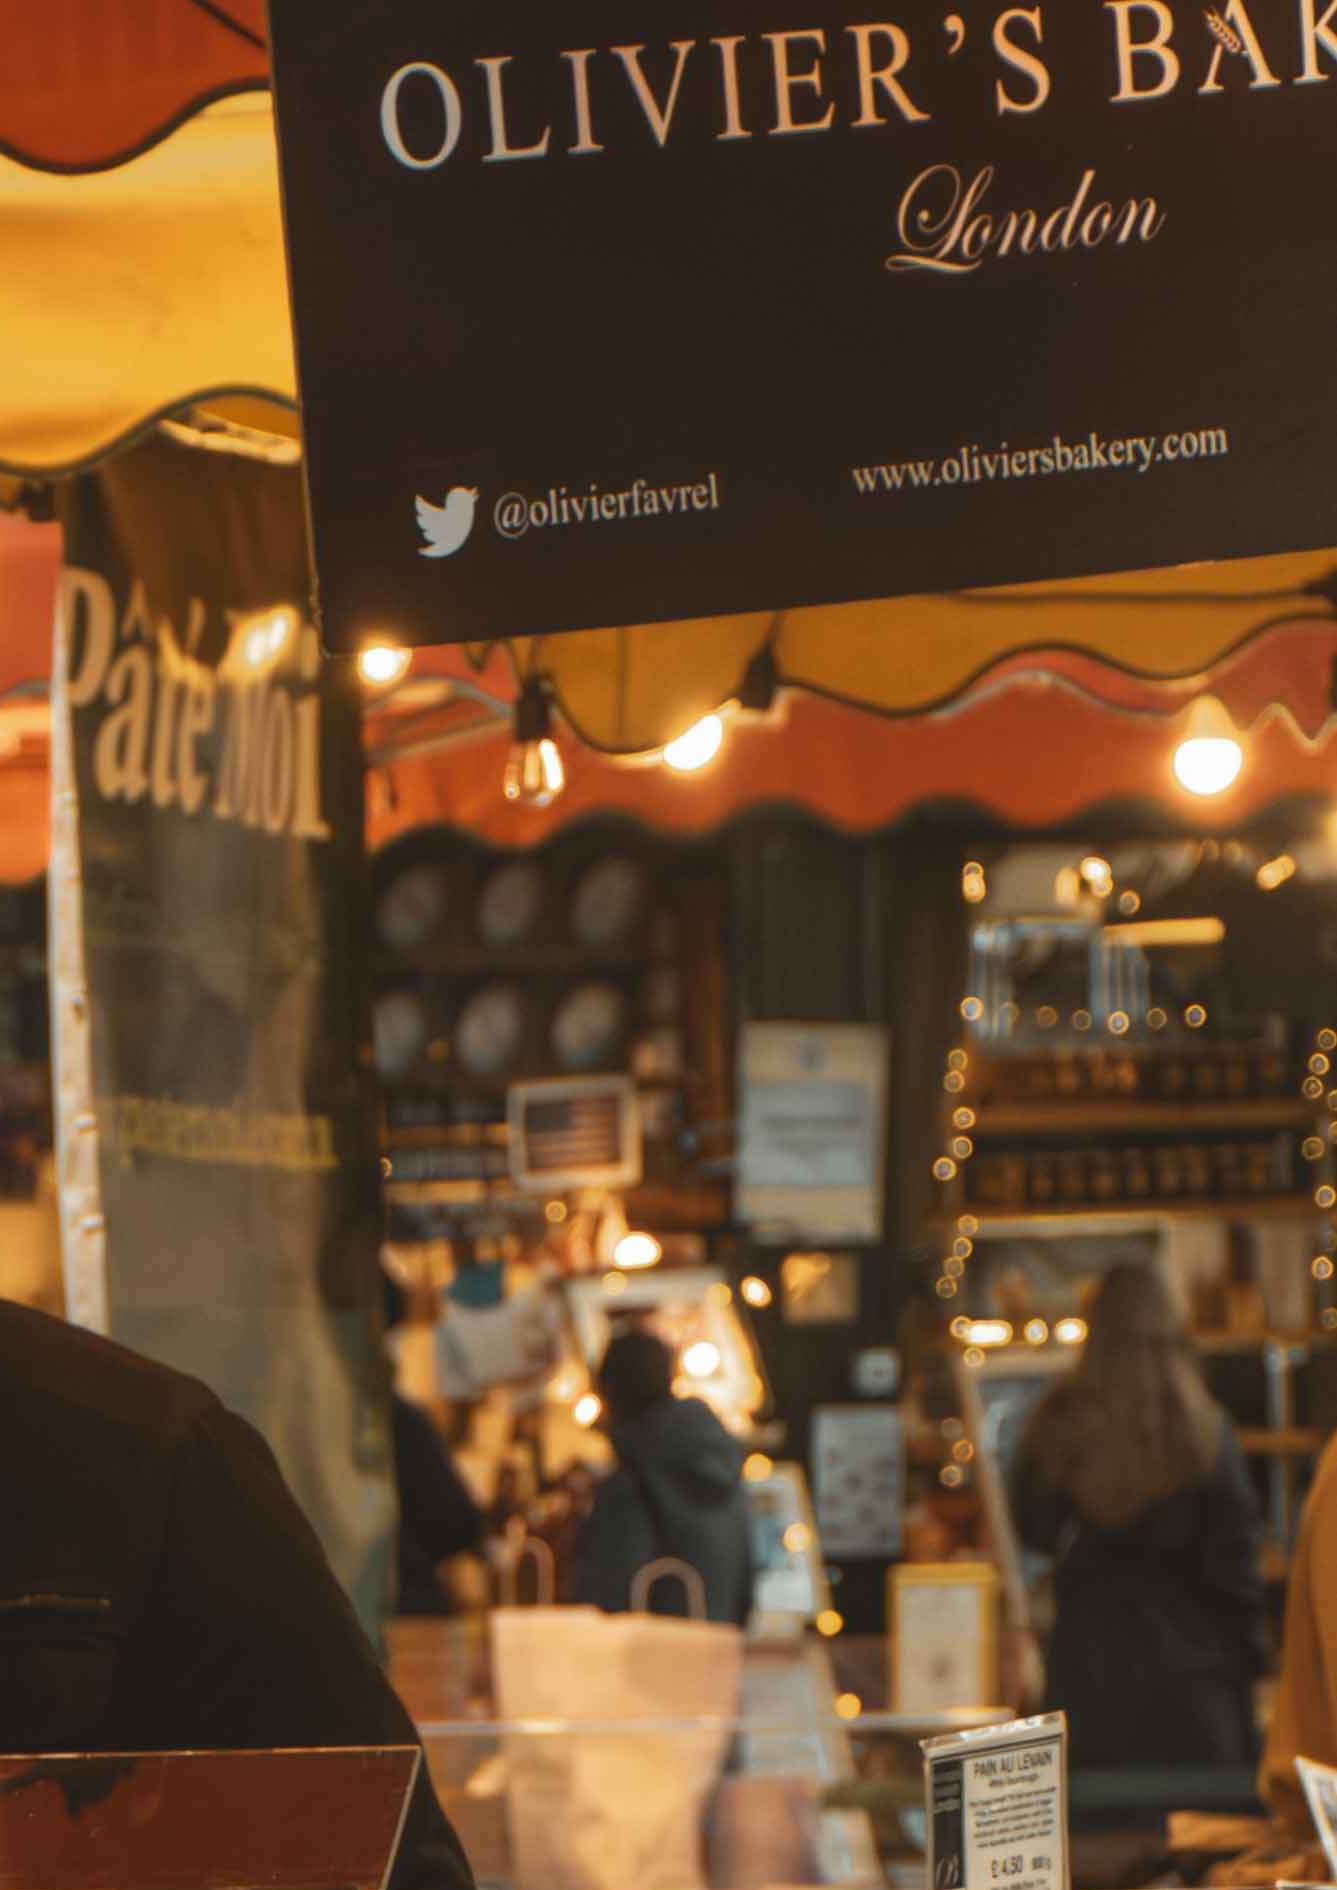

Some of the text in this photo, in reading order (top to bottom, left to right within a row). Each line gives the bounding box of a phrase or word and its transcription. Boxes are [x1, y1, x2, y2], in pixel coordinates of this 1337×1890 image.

[380, 4, 1051, 169] OLIVIER'S
[885, 163, 1165, 273] London
[852, 427, 1228, 494] www.oliviersbakery.com
[493, 473, 720, 538] @olivierfavrel
